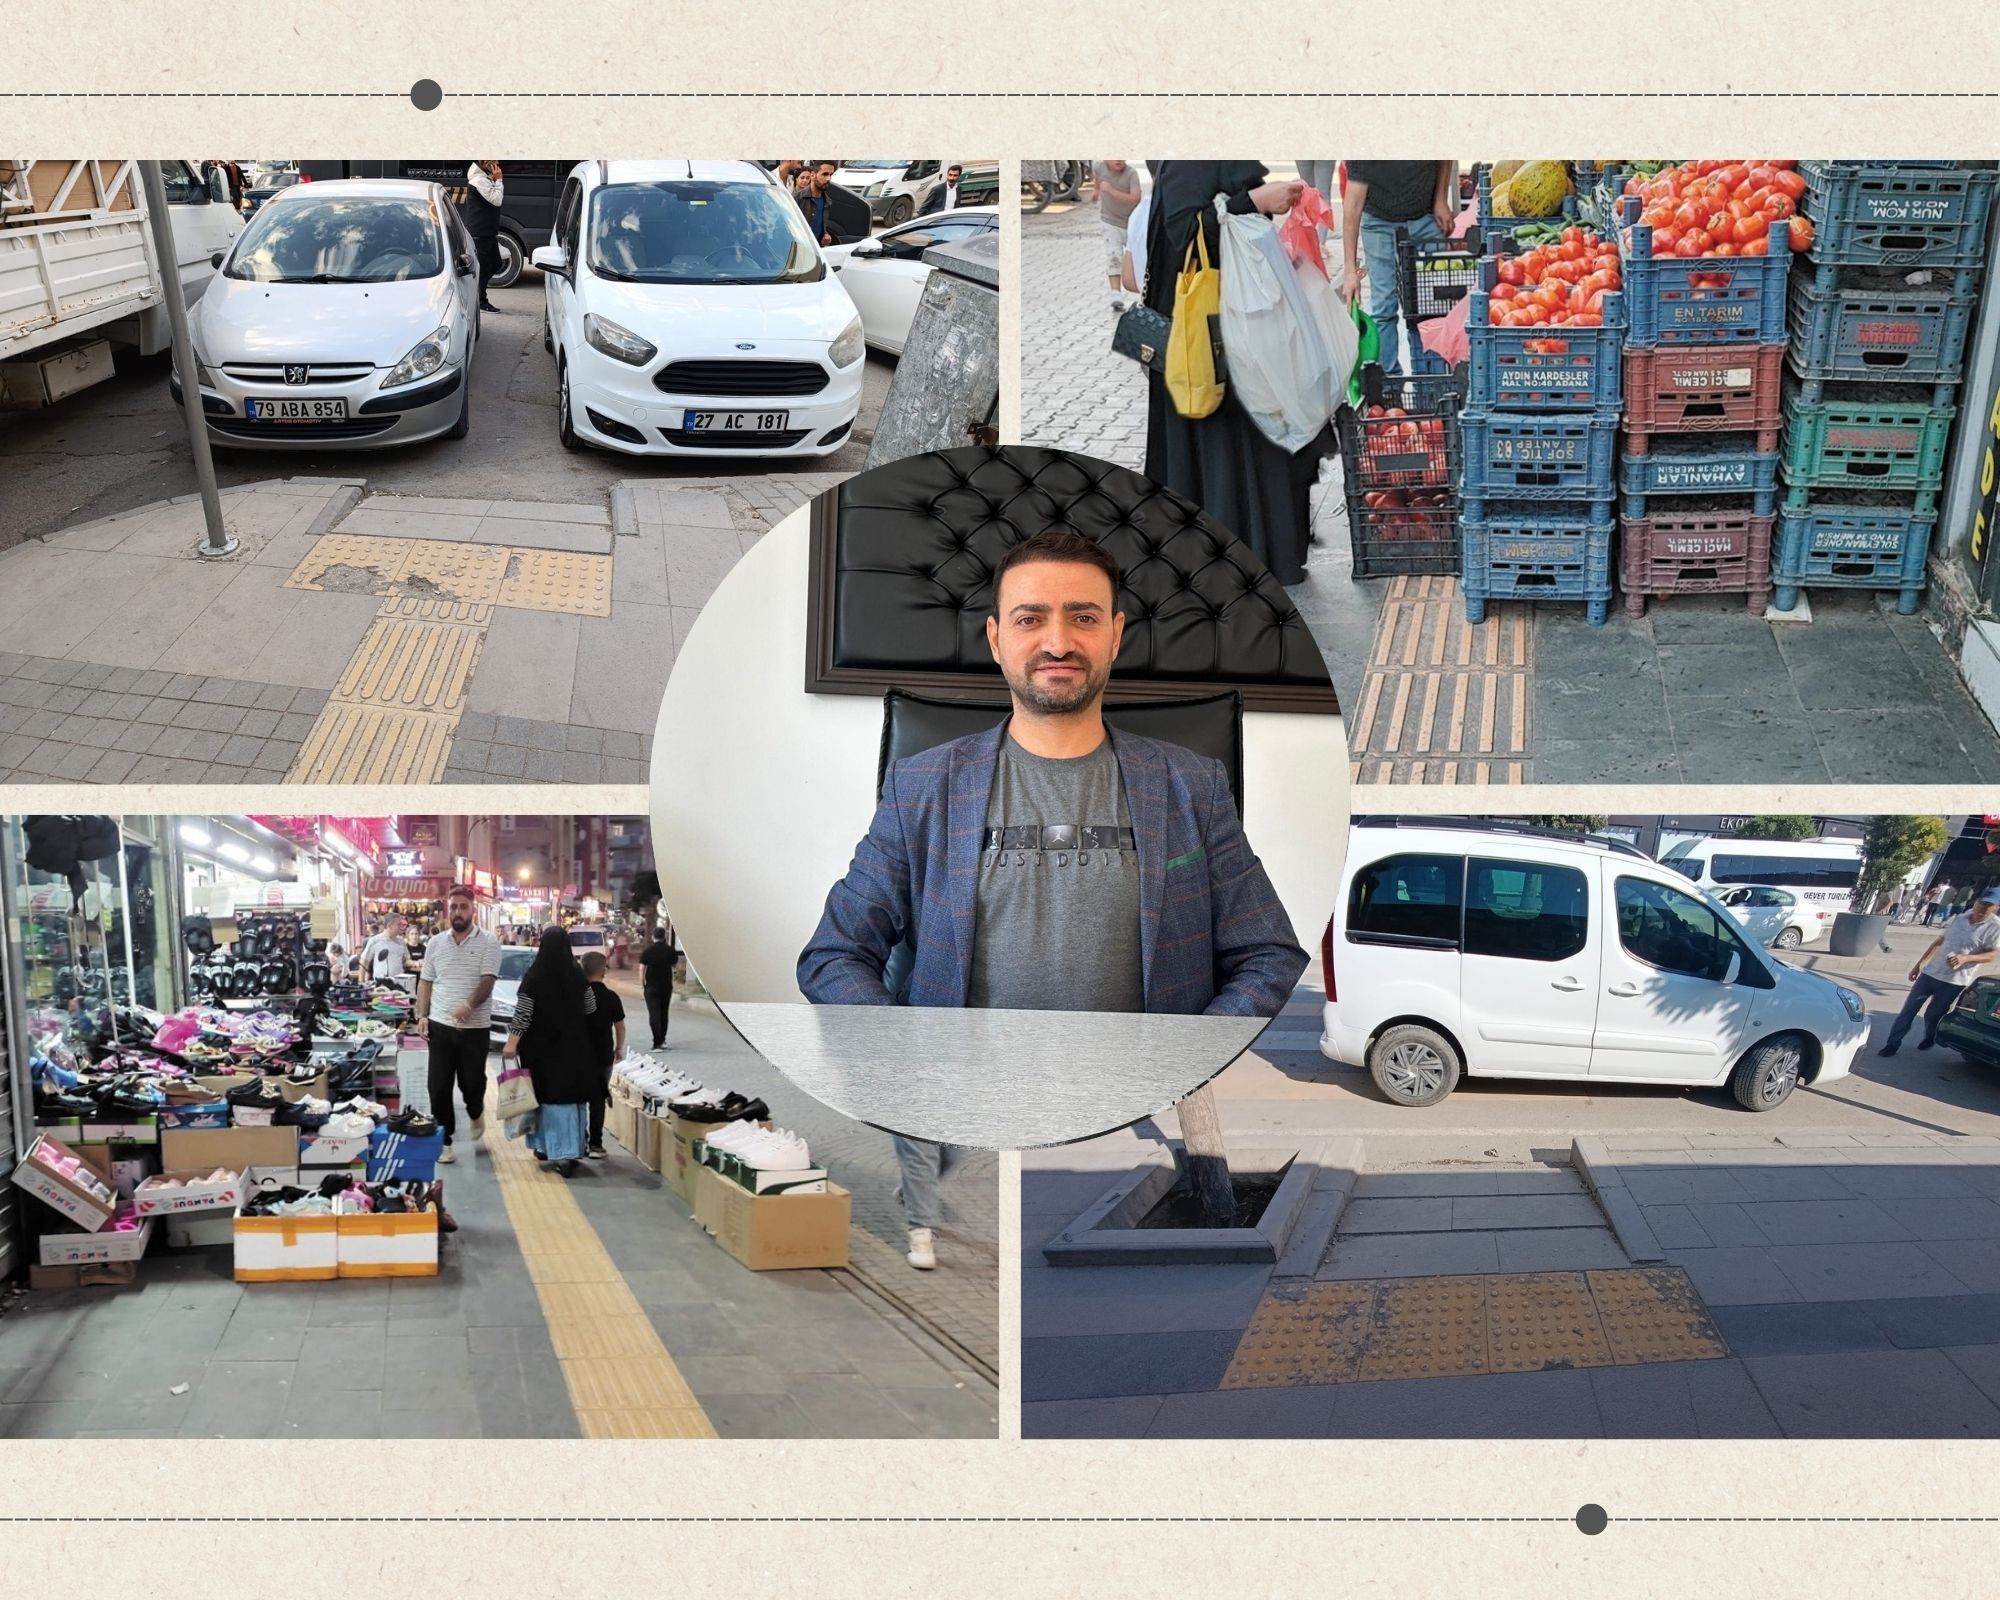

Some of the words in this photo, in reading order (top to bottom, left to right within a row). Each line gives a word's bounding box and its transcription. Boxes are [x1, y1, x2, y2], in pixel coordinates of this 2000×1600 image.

[1868, 199, 1899, 207] VAN
[1870, 207, 1907, 218] KOM.
[1912, 208, 1943, 219] NUR
[1674, 307, 1694, 317] EN
[1699, 306, 1743, 317] TARIM
[1502, 371, 1530, 380] AYDIN
[1712, 377, 1729, 386] ACI
[255, 402, 275, 417] 79
[281, 402, 309, 417] ABA
[314, 402, 343, 417] 854
[695, 414, 715, 429] 27
[725, 414, 744, 429] AC
[757, 414, 783, 430] 181
[1547, 449, 1574, 460] SOF
[1657, 472, 1745, 483] AYHANLAR
[1720, 817, 1749, 829] EKO
[985, 852, 1043, 867] JUST
[1057, 852, 1089, 868] DO
[1804, 891, 1826, 901] GEVER
